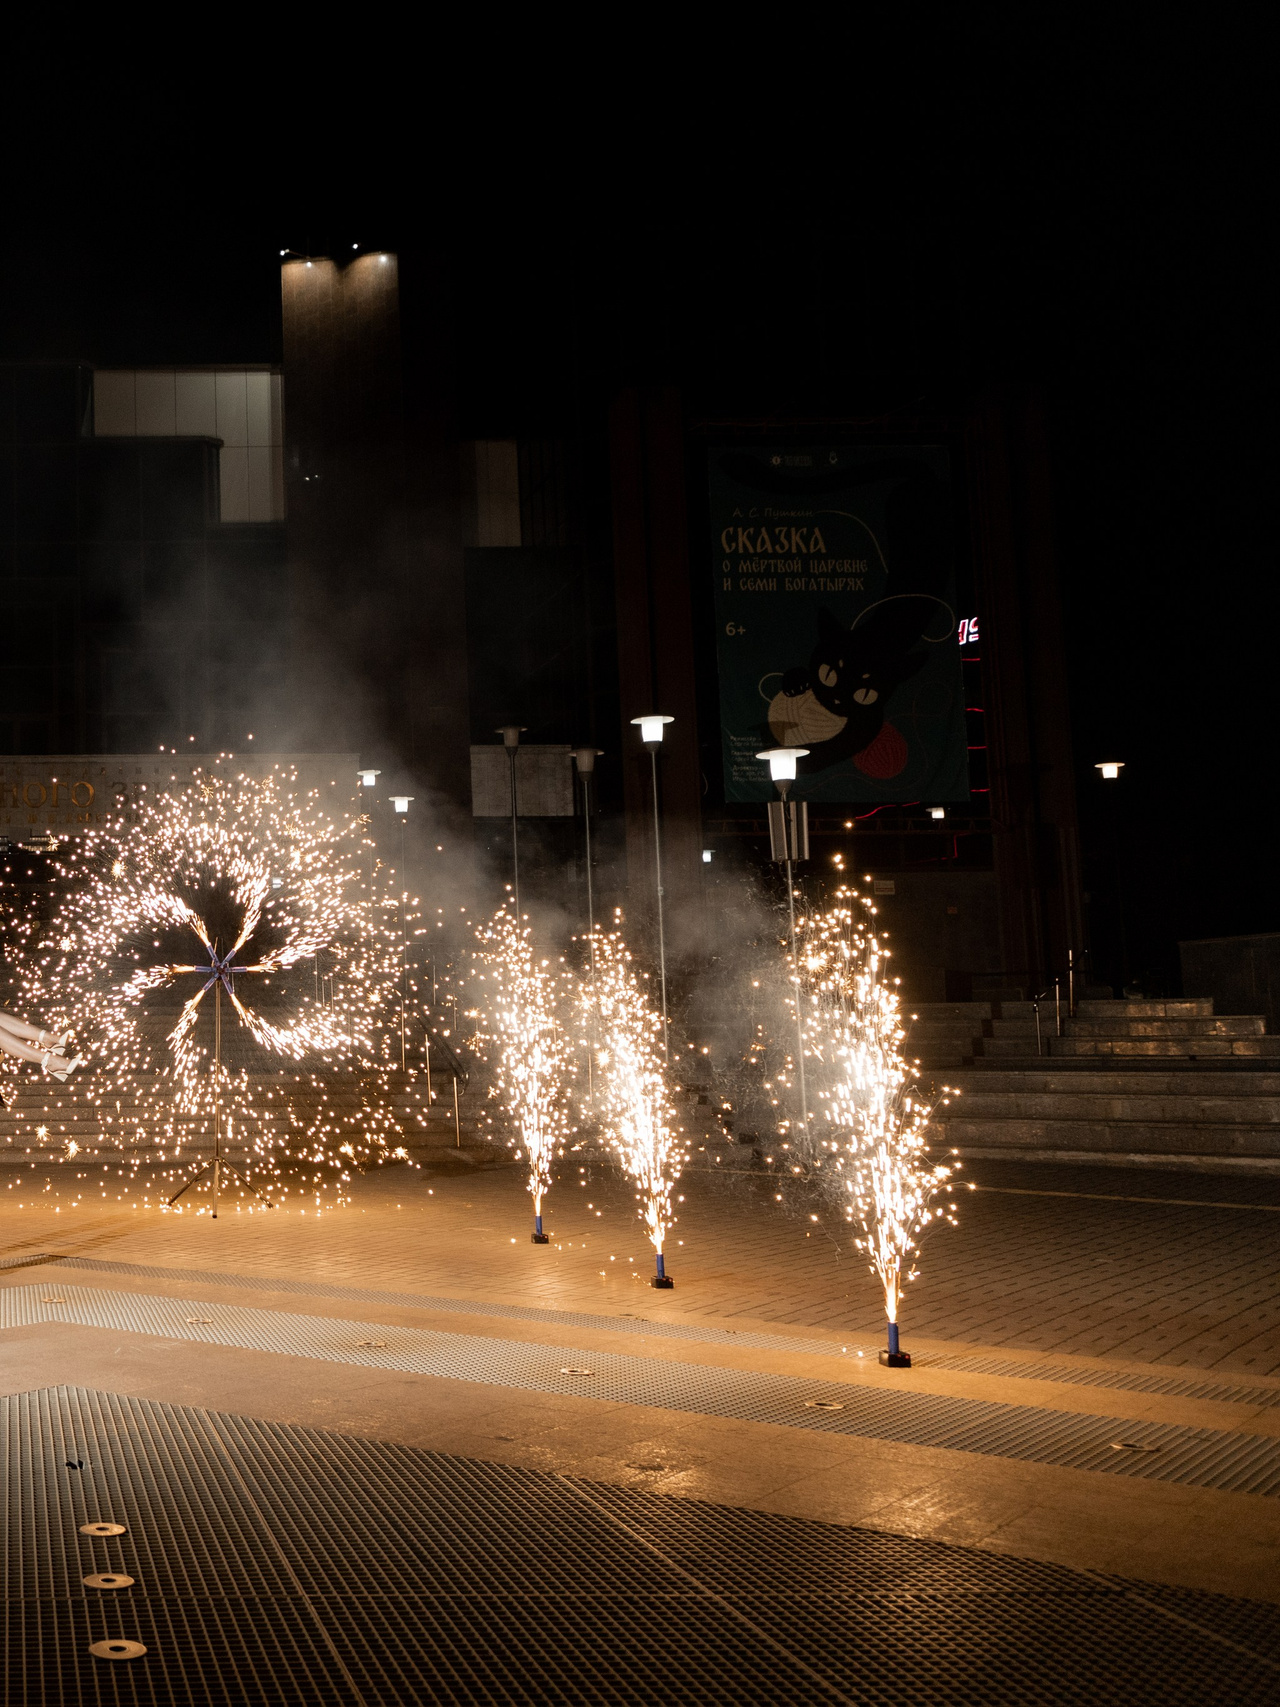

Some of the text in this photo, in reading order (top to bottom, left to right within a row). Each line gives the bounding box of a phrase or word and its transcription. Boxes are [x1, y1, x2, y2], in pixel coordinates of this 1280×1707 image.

[764, 507, 815, 520] Пушкин
[720, 525, 828, 555] СКАЗКА
[722, 556, 869, 575] О МЁРТВОЙ ЦАРЕВНЕ
[722, 576, 865, 592] И СЕМИ БОГАТЫРЯХ
[725, 621, 747, 637] 6+
